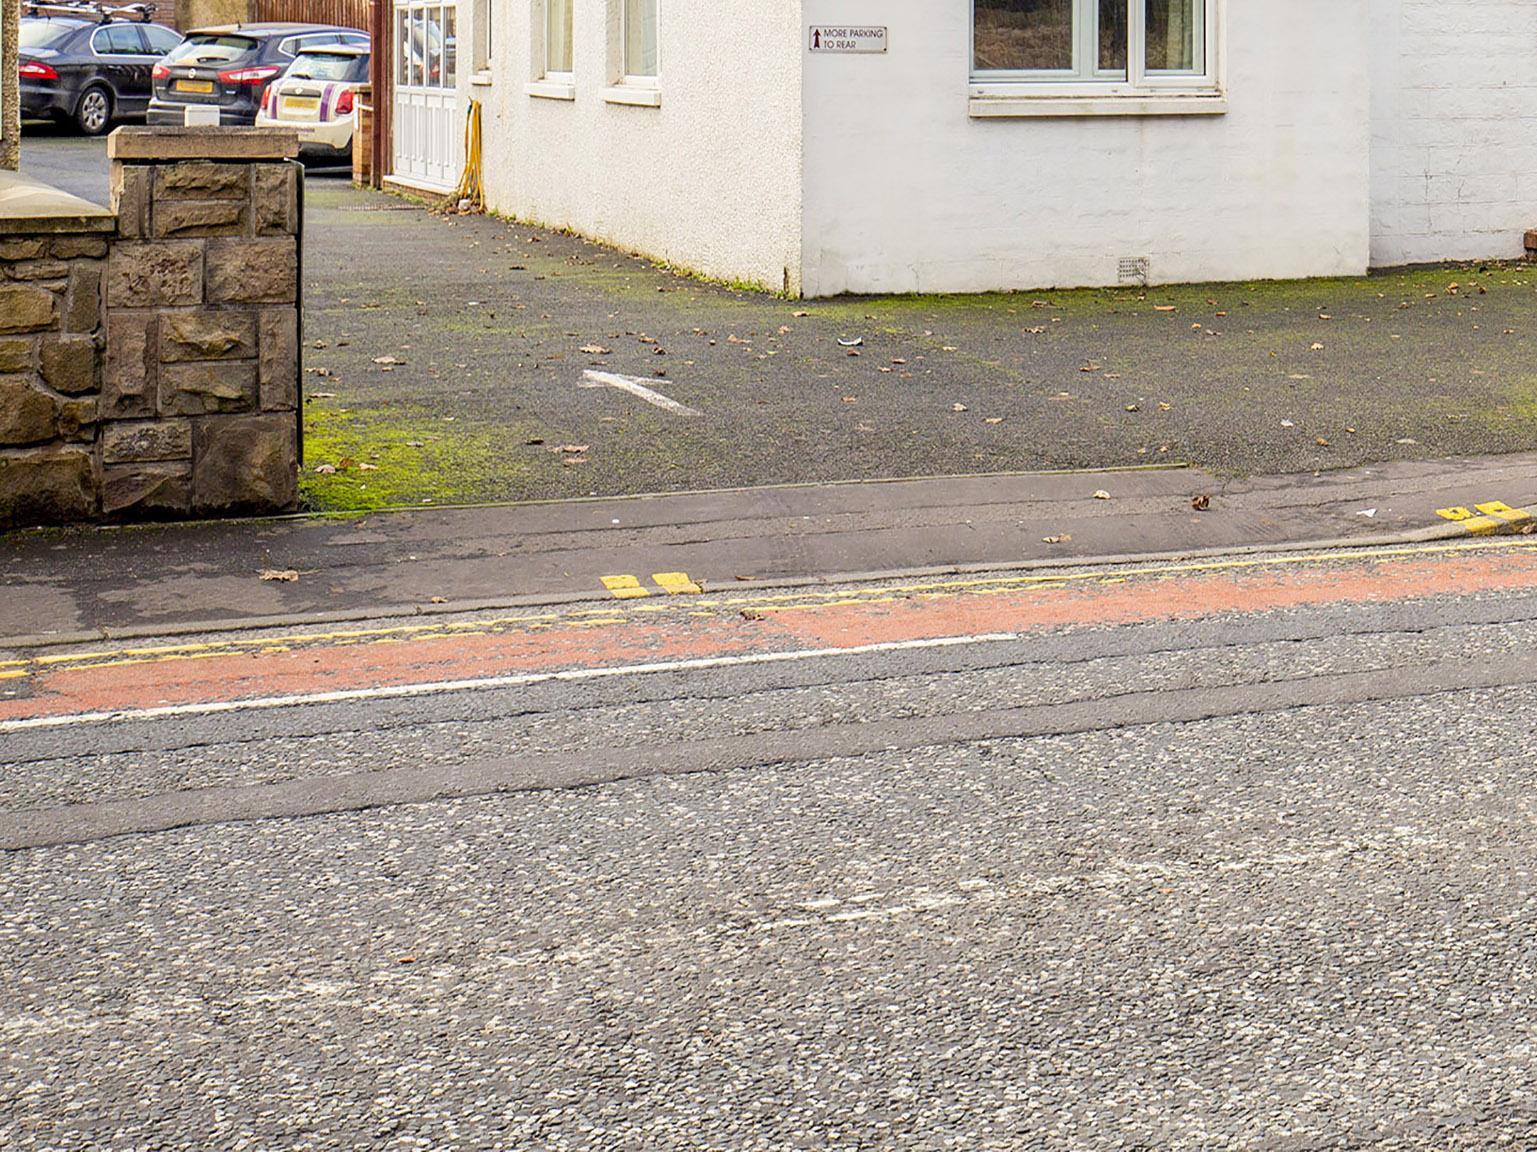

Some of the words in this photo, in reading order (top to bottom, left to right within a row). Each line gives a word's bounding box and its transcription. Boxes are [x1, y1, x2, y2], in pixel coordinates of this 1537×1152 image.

[823, 29, 847, 38] MORE
[849, 29, 883, 39] PARKING
[824, 40, 835, 49] TO
[836, 40, 857, 49] REAR
